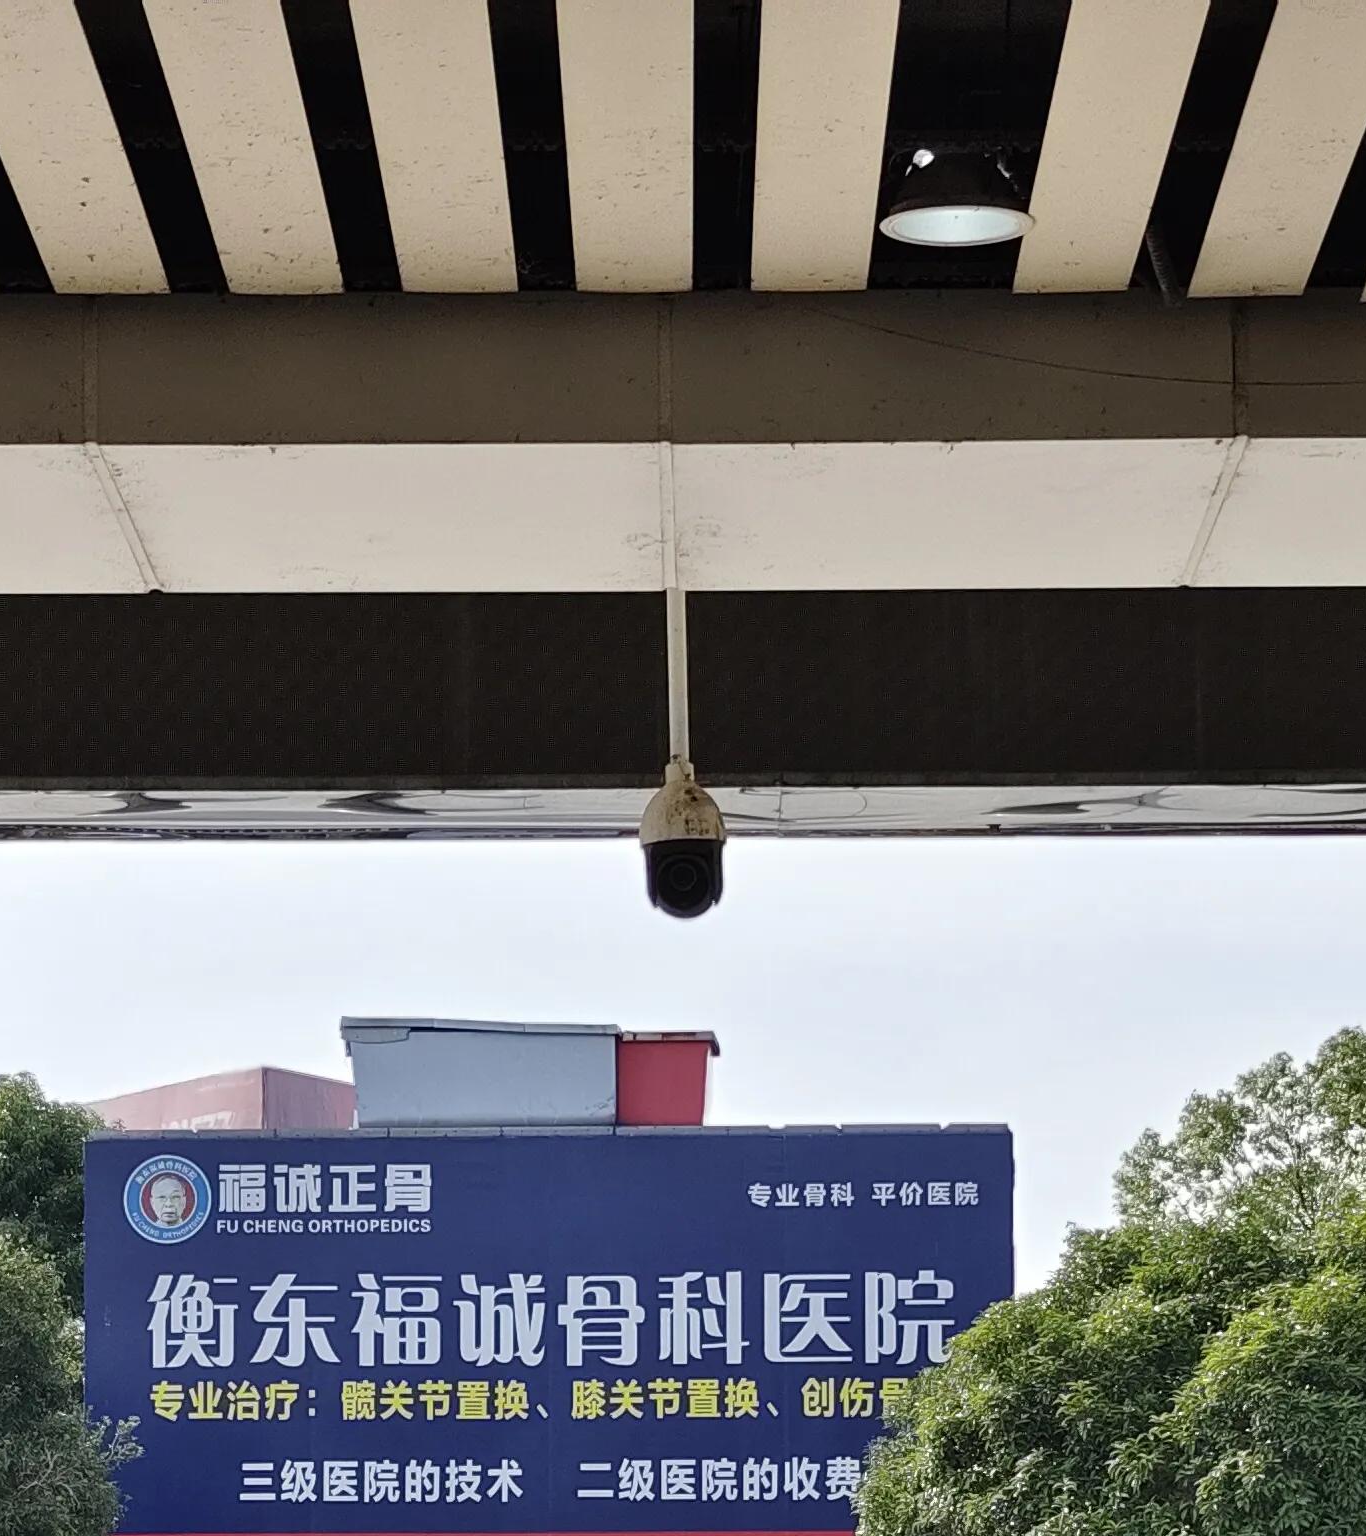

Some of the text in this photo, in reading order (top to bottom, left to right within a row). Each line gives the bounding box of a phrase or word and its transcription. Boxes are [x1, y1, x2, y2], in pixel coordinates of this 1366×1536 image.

[218, 1163, 432, 1213] 福诚正骨
[747, 1181, 980, 1208] 专业骨科 平价医院
[216, 1218, 432, 1234] FU CHENG ORTHOPEDICS
[146, 1270, 955, 1369] 衡东福诚骨科医院
[239, 1456, 863, 1503] 三级医院的技术 二级医院的收费
